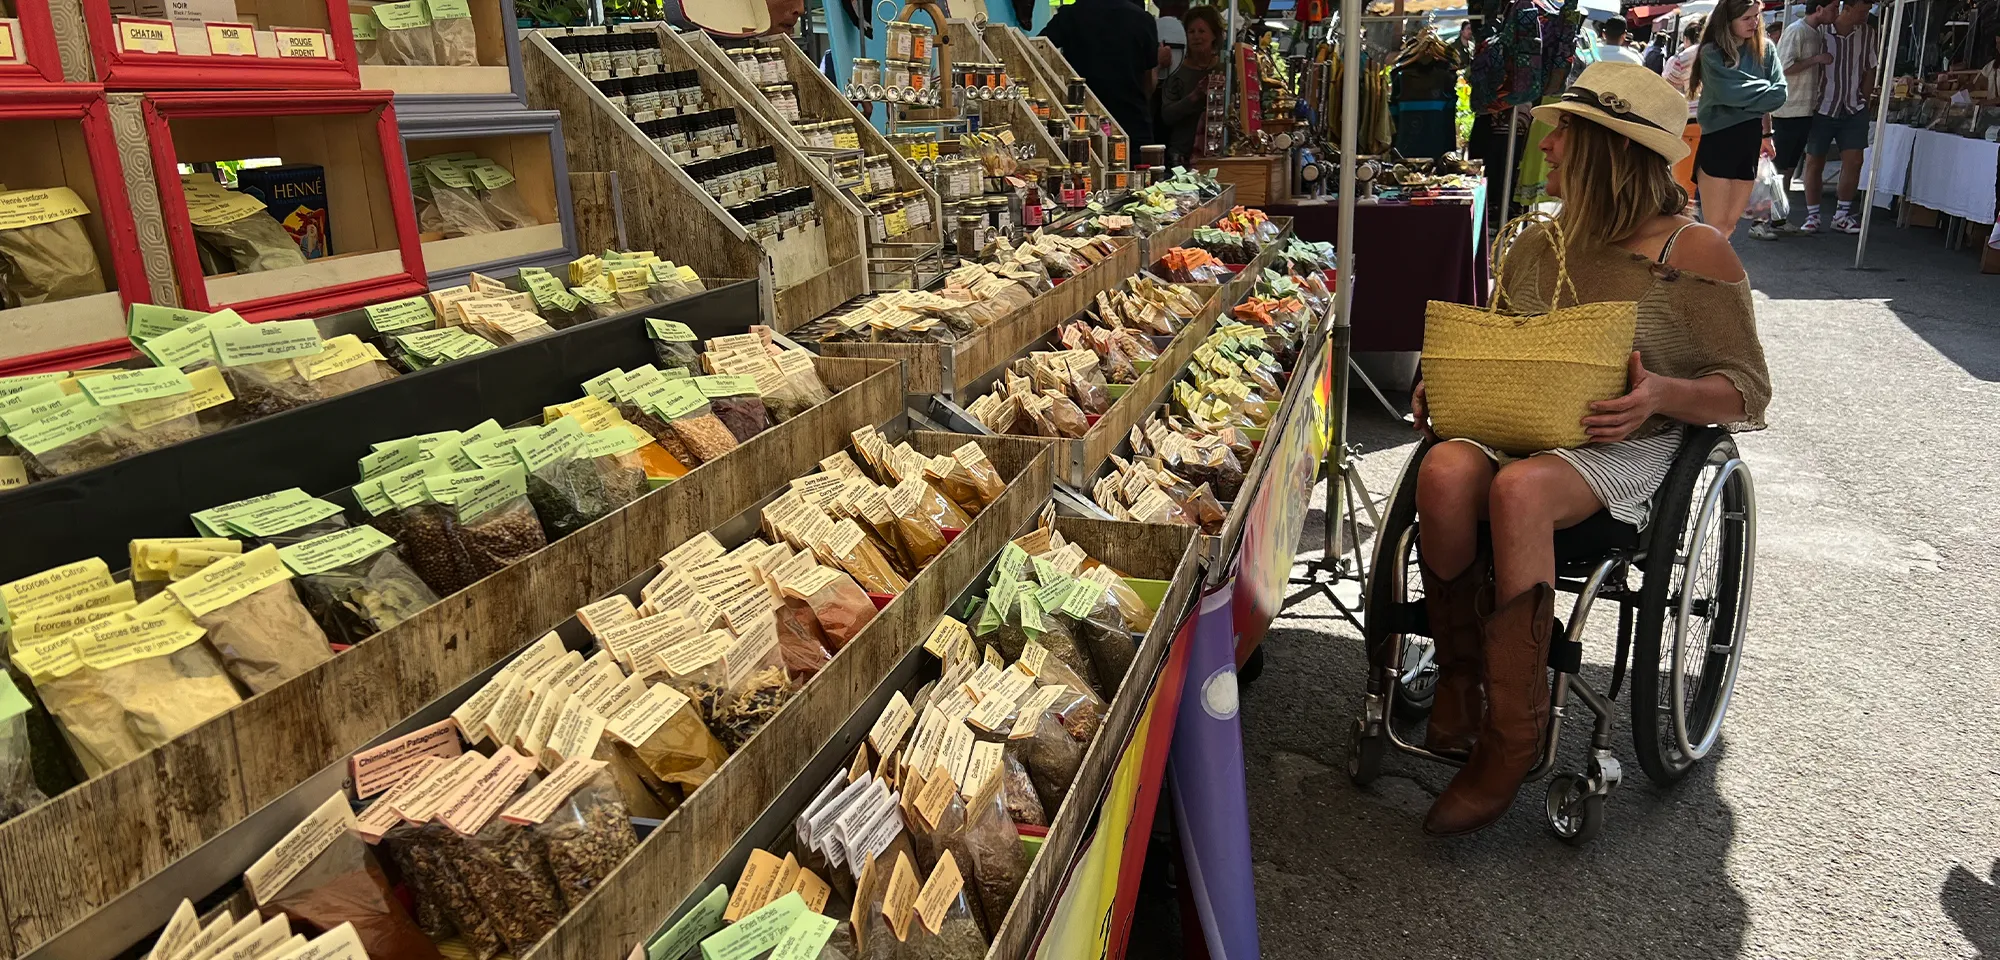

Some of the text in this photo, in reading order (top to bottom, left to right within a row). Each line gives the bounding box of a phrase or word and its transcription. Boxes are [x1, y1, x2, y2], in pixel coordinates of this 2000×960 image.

[130, 29, 163, 39] CHATAIN
[222, 29, 239, 38] NOIR
[290, 38, 312, 46] ROUGE
[274, 176, 322, 199] HENNÉ
[376, 302, 401, 313] Cardamome
[172, 313, 189, 322] Basilic
[186, 322, 207, 334] Basilic
[262, 326, 282, 336] Basilic
[416, 337, 440, 349] Cardamome
[112, 370, 144, 382] Anis vert
[7, 396, 22, 408] vert
[30, 400, 62, 415] Anis vert
[56, 408, 73, 419] vert
[418, 436, 438, 444] riandre
[460, 433, 482, 446] Coriandre
[539, 427, 558, 440] Coriandre
[494, 437, 516, 448] Coriandre
[377, 449, 400, 464] Coriandre
[400, 468, 424, 483] Coriandre
[450, 474, 486, 486] Coriandre
[474, 478, 500, 496] Coriandre
[819, 488, 831, 498] Curry
[204, 559, 246, 582] Citronnelle
[14, 566, 88, 594] Écorces de Citron
[86, 594, 110, 608] Citron
[34, 618, 72, 633] Écorces
[74, 617, 85, 626] de
[94, 618, 166, 642] Écorces de Citron
[606, 614, 668, 640] Épices court-bouillon
[651, 624, 686, 646] court-bouillon
[680, 634, 712, 650] court-bouillon
[524, 644, 546, 662] Colombo
[580, 660, 598, 677] Colombo
[589, 672, 608, 691] Colombo
[610, 684, 632, 702] Colombo
[635, 692, 655, 709] Colombo
[360, 726, 450, 768] Chimichurri Patagonico
[920, 729, 932, 750] Grillades
[942, 736, 953, 758] Grillades
[548, 760, 580, 789] Patagonico
[972, 758, 982, 779] Grillades
[399, 756, 475, 812] Chimichurri Patagonico
[443, 756, 512, 820] Chimichurri Patagonico
[301, 817, 318, 834] Chili
[739, 906, 778, 934] Fines herbes
